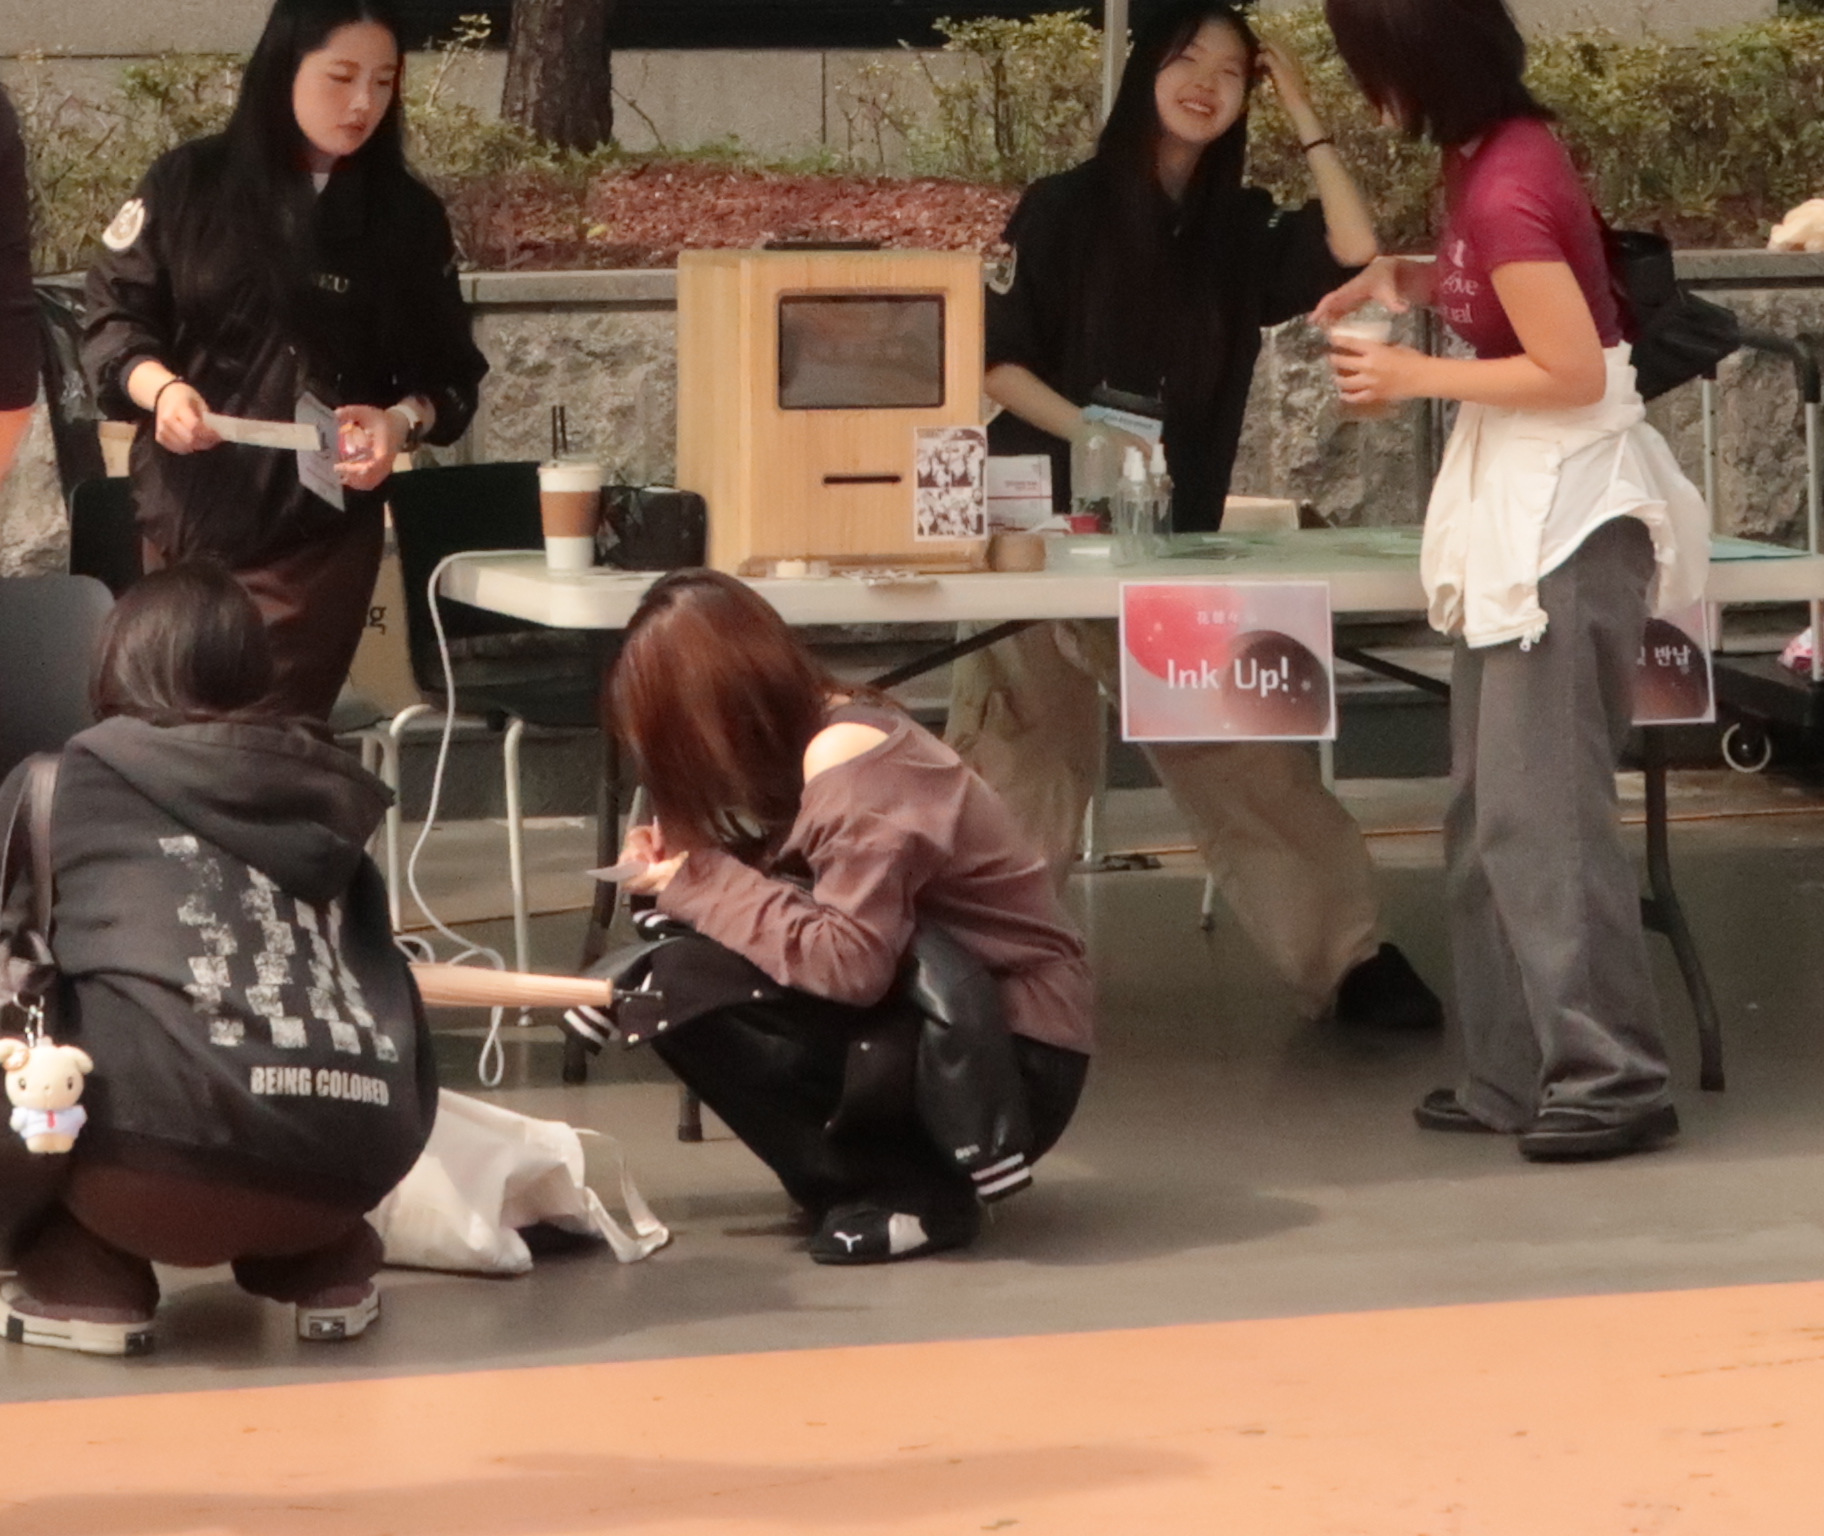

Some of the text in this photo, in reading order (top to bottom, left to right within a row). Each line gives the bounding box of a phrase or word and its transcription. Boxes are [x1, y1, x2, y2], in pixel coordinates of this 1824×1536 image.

[1167, 655, 1290, 700] Ink Up!
[250, 1066, 390, 1106] BEING COLORED
